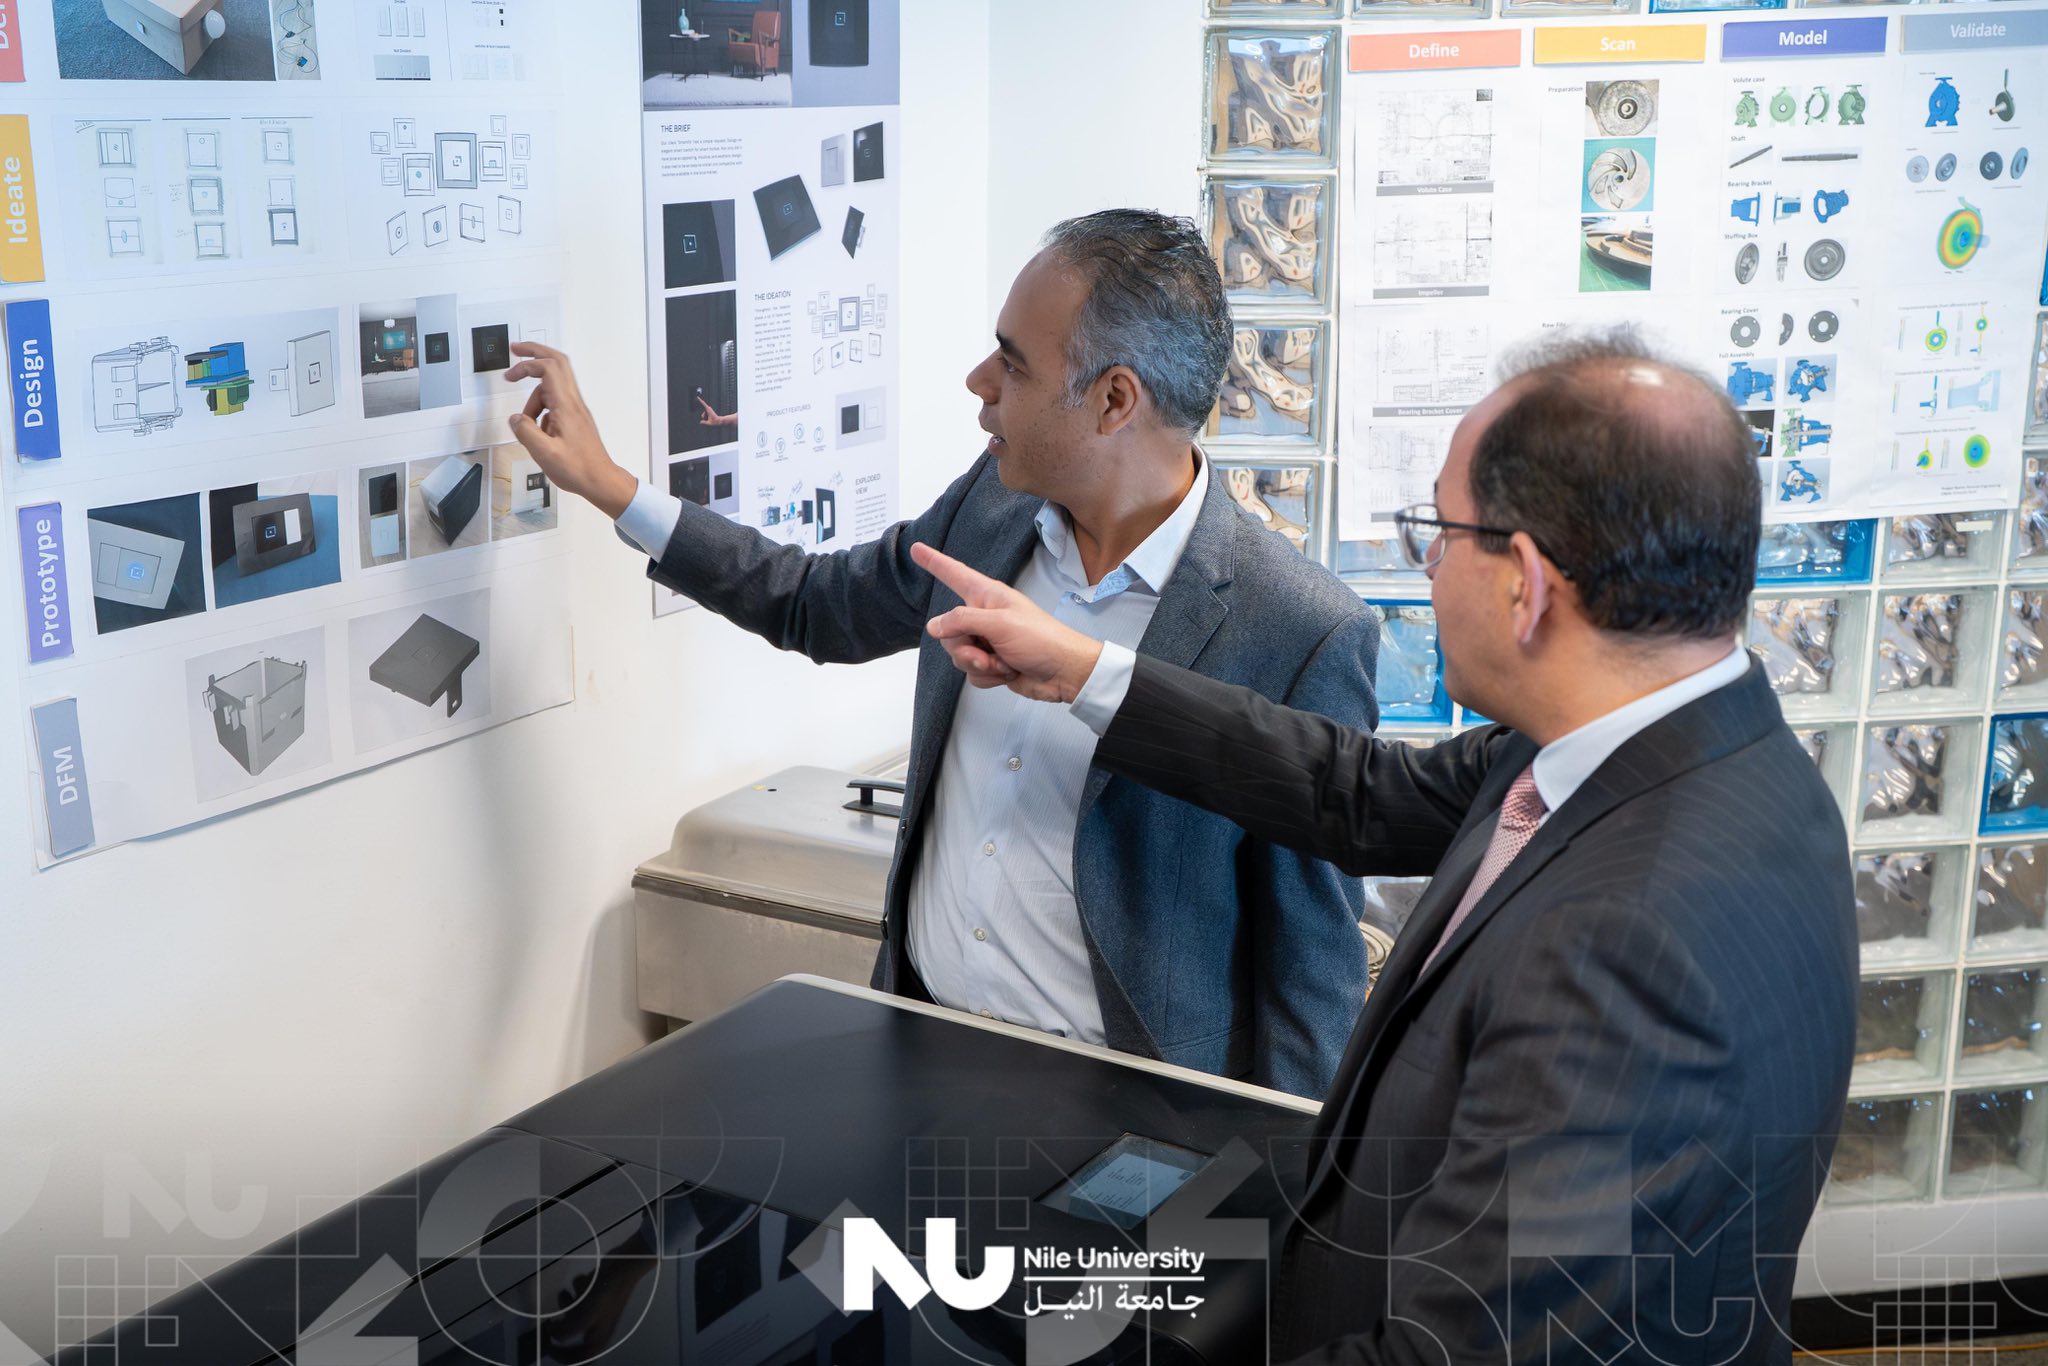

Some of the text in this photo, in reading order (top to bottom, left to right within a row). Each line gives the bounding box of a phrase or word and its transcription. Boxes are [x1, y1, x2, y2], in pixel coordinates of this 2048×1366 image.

[1779, 30, 1827, 46] Model
[1950, 23, 2006, 38] Validate
[1409, 43, 1459, 58] Define
[1600, 37, 1636, 52] Scan
[661, 124, 691, 133] THE BRIEF
[4, 156, 28, 243] Ideate
[755, 290, 791, 301] THE IDEATION
[20, 339, 44, 428] Design
[36, 518, 61, 649] Prototype
[53, 745, 78, 806] DFM
